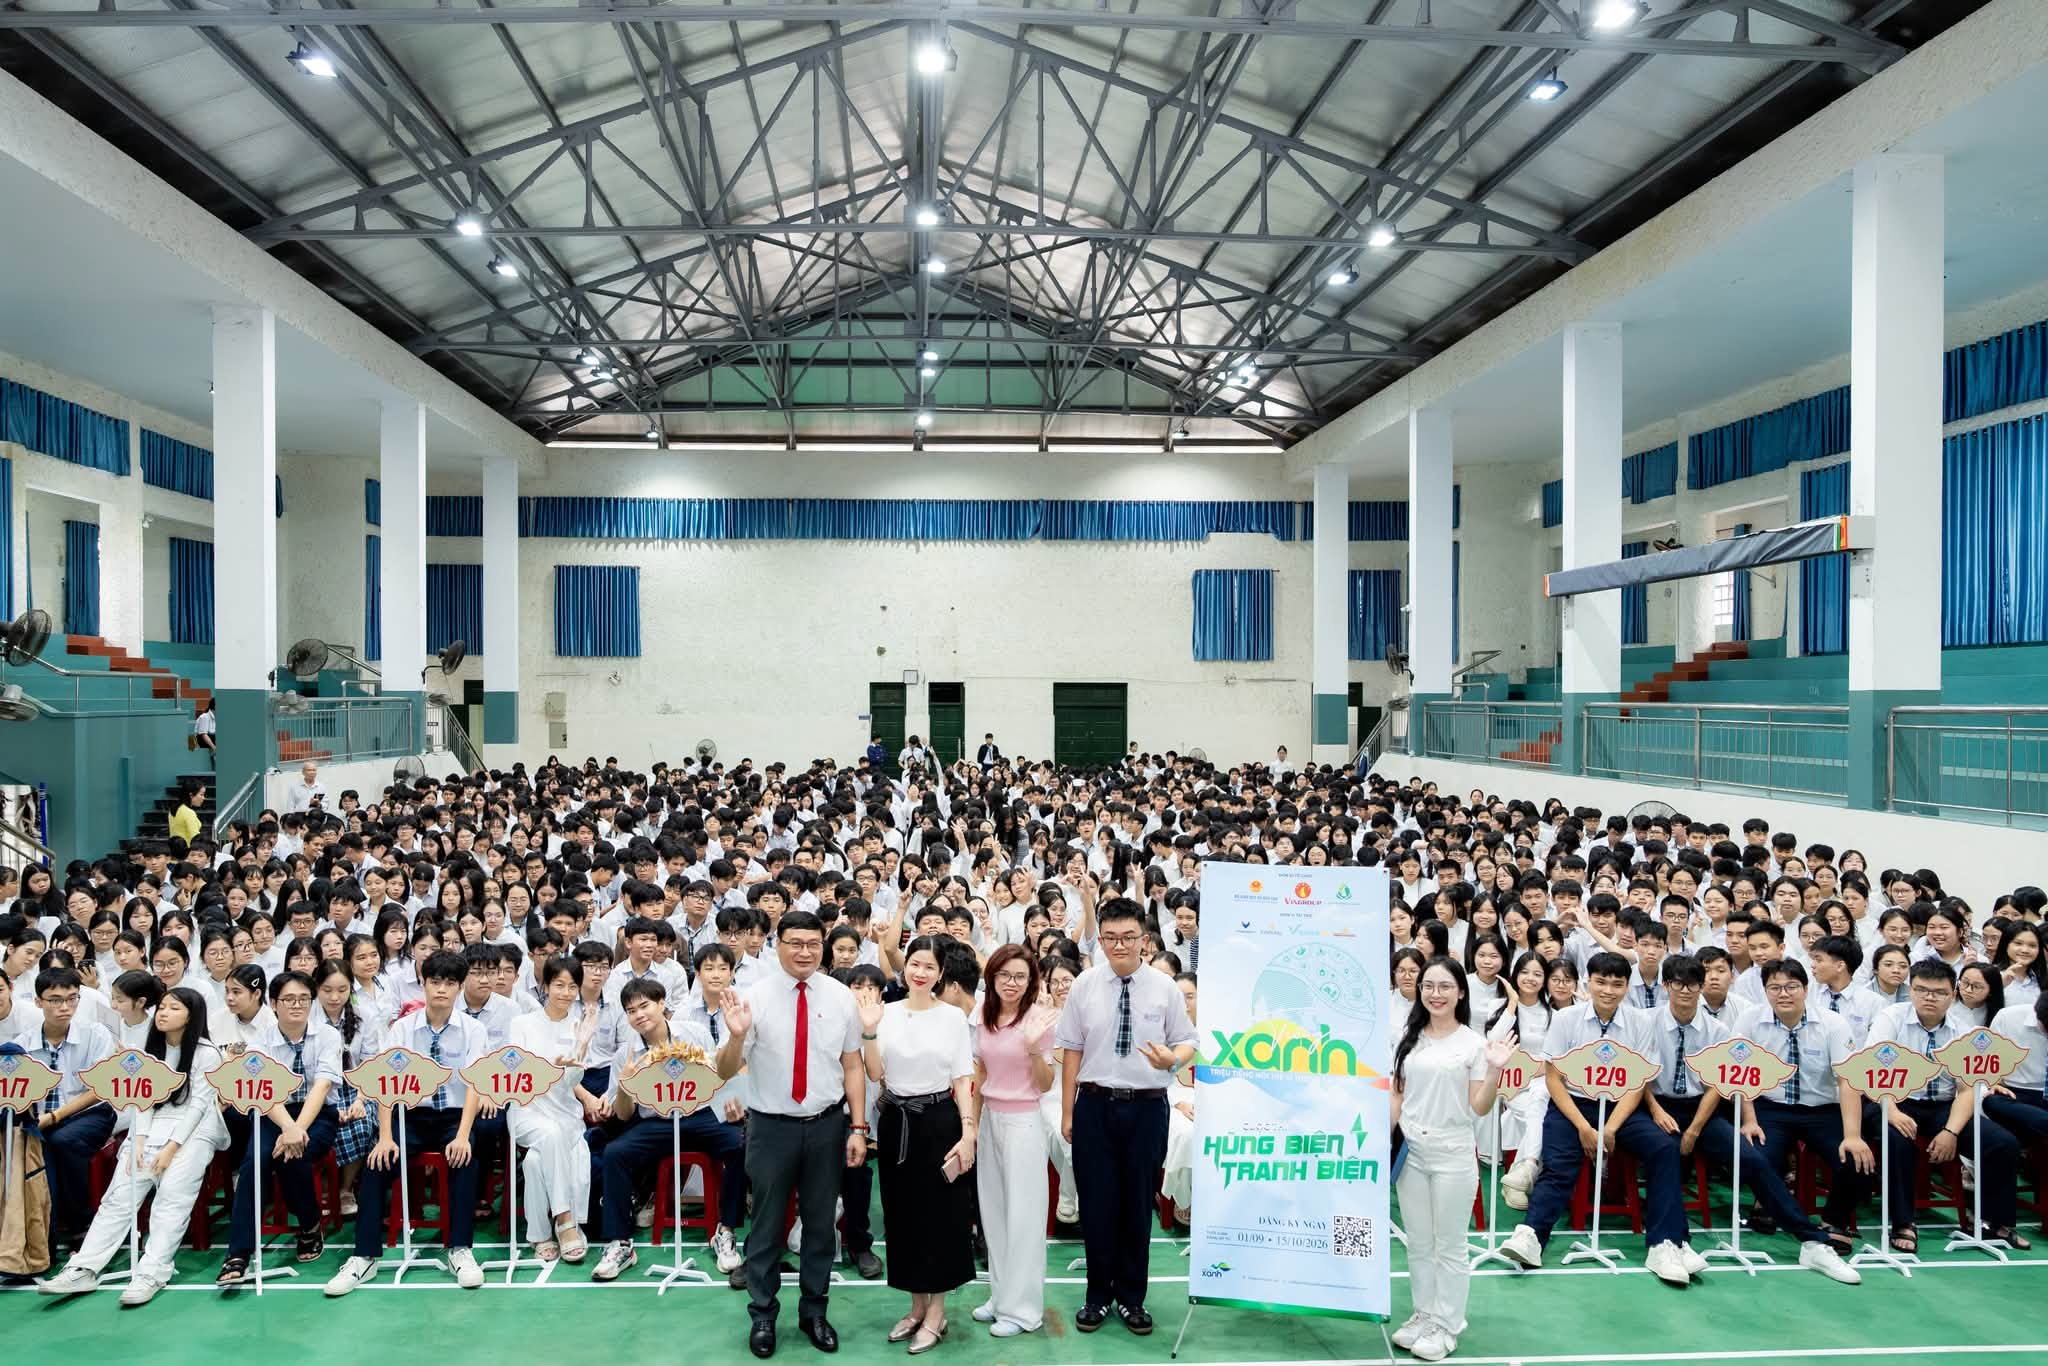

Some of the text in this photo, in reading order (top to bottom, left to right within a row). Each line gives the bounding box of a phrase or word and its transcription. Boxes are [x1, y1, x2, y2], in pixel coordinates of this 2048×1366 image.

[1718, 1064, 1761, 1087] 12/8
[1964, 1055, 2000, 1075] 12/6
[378, 1074, 421, 1095] 11/4
[491, 1072, 533, 1093] 11/3
[1497, 1067, 1522, 1088] /10
[1584, 1065, 1627, 1088] 12/9
[1866, 1068, 1908, 1089] 12/7
[0, 1077, 30, 1098] 1/7
[111, 1077, 153, 1099] 11/6
[235, 1078, 273, 1101] 11/5
[654, 1080, 697, 1103] 11/2
[1284, 1130, 1345, 1158] BIỆN
[1220, 1155, 1379, 1191] TRANH BIỆN
[1303, 1219, 1327, 1230] NGAY
[1237, 1231, 1265, 1244] 01/09
